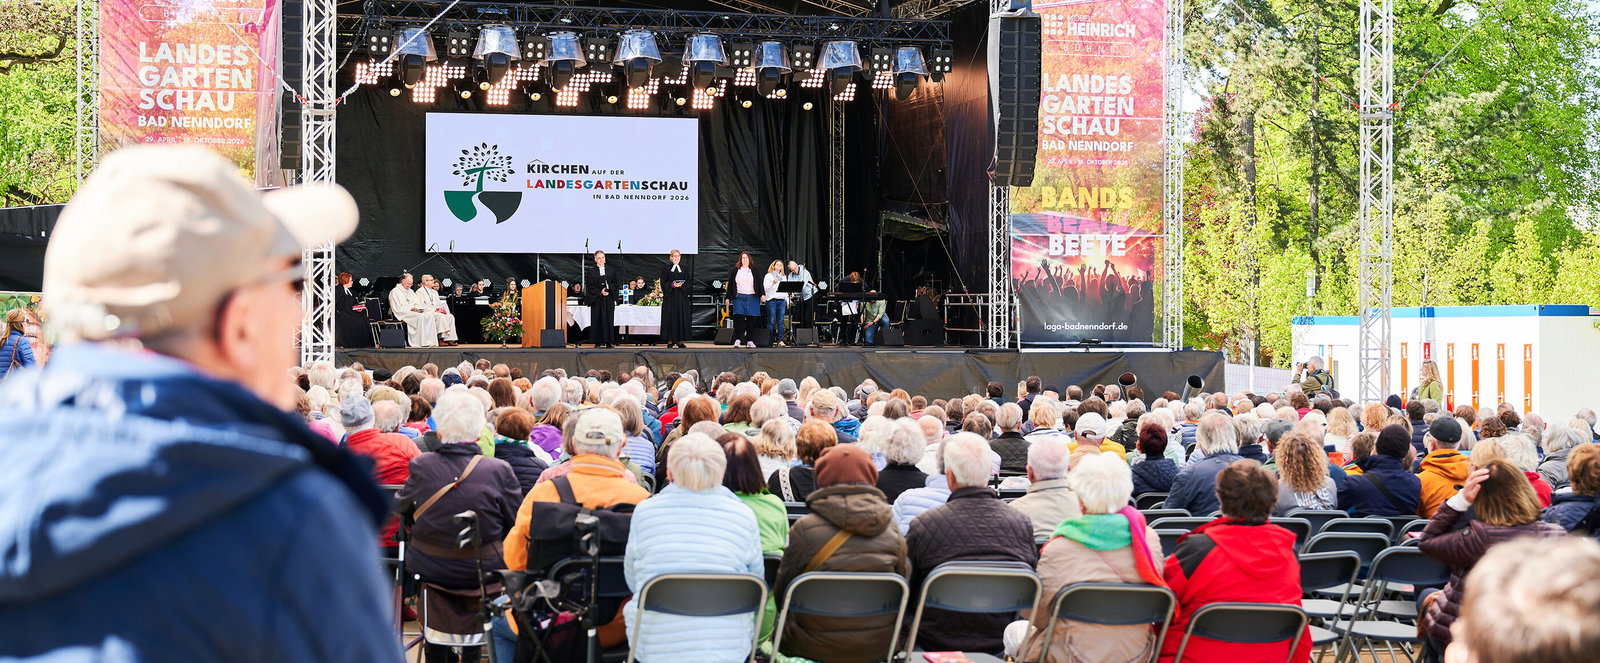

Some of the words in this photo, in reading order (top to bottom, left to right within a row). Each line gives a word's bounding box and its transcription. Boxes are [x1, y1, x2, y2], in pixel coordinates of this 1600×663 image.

[1068, 22, 1136, 38] HEINRICH
[139, 42, 249, 66] LANDES
[139, 66, 252, 90] GARTEN
[1044, 73, 1132, 94] LANDES
[138, 90, 234, 112] SCHAU
[1043, 95, 1134, 115] GARTEN
[138, 115, 168, 128] BAD
[171, 116, 252, 130] NENNDORF
[1042, 117, 1120, 136] SCHAU
[1042, 140, 1064, 150] BAD
[1069, 141, 1134, 152] NENNDORF
[527, 164, 589, 174] KIRCHEN
[527, 179, 688, 190] LANDESGARTENSCHAU
[1042, 186, 1133, 208] BANDS
[1049, 234, 1126, 256] BEETE
[1044, 322, 1128, 332] laga-badnenndorf.de
